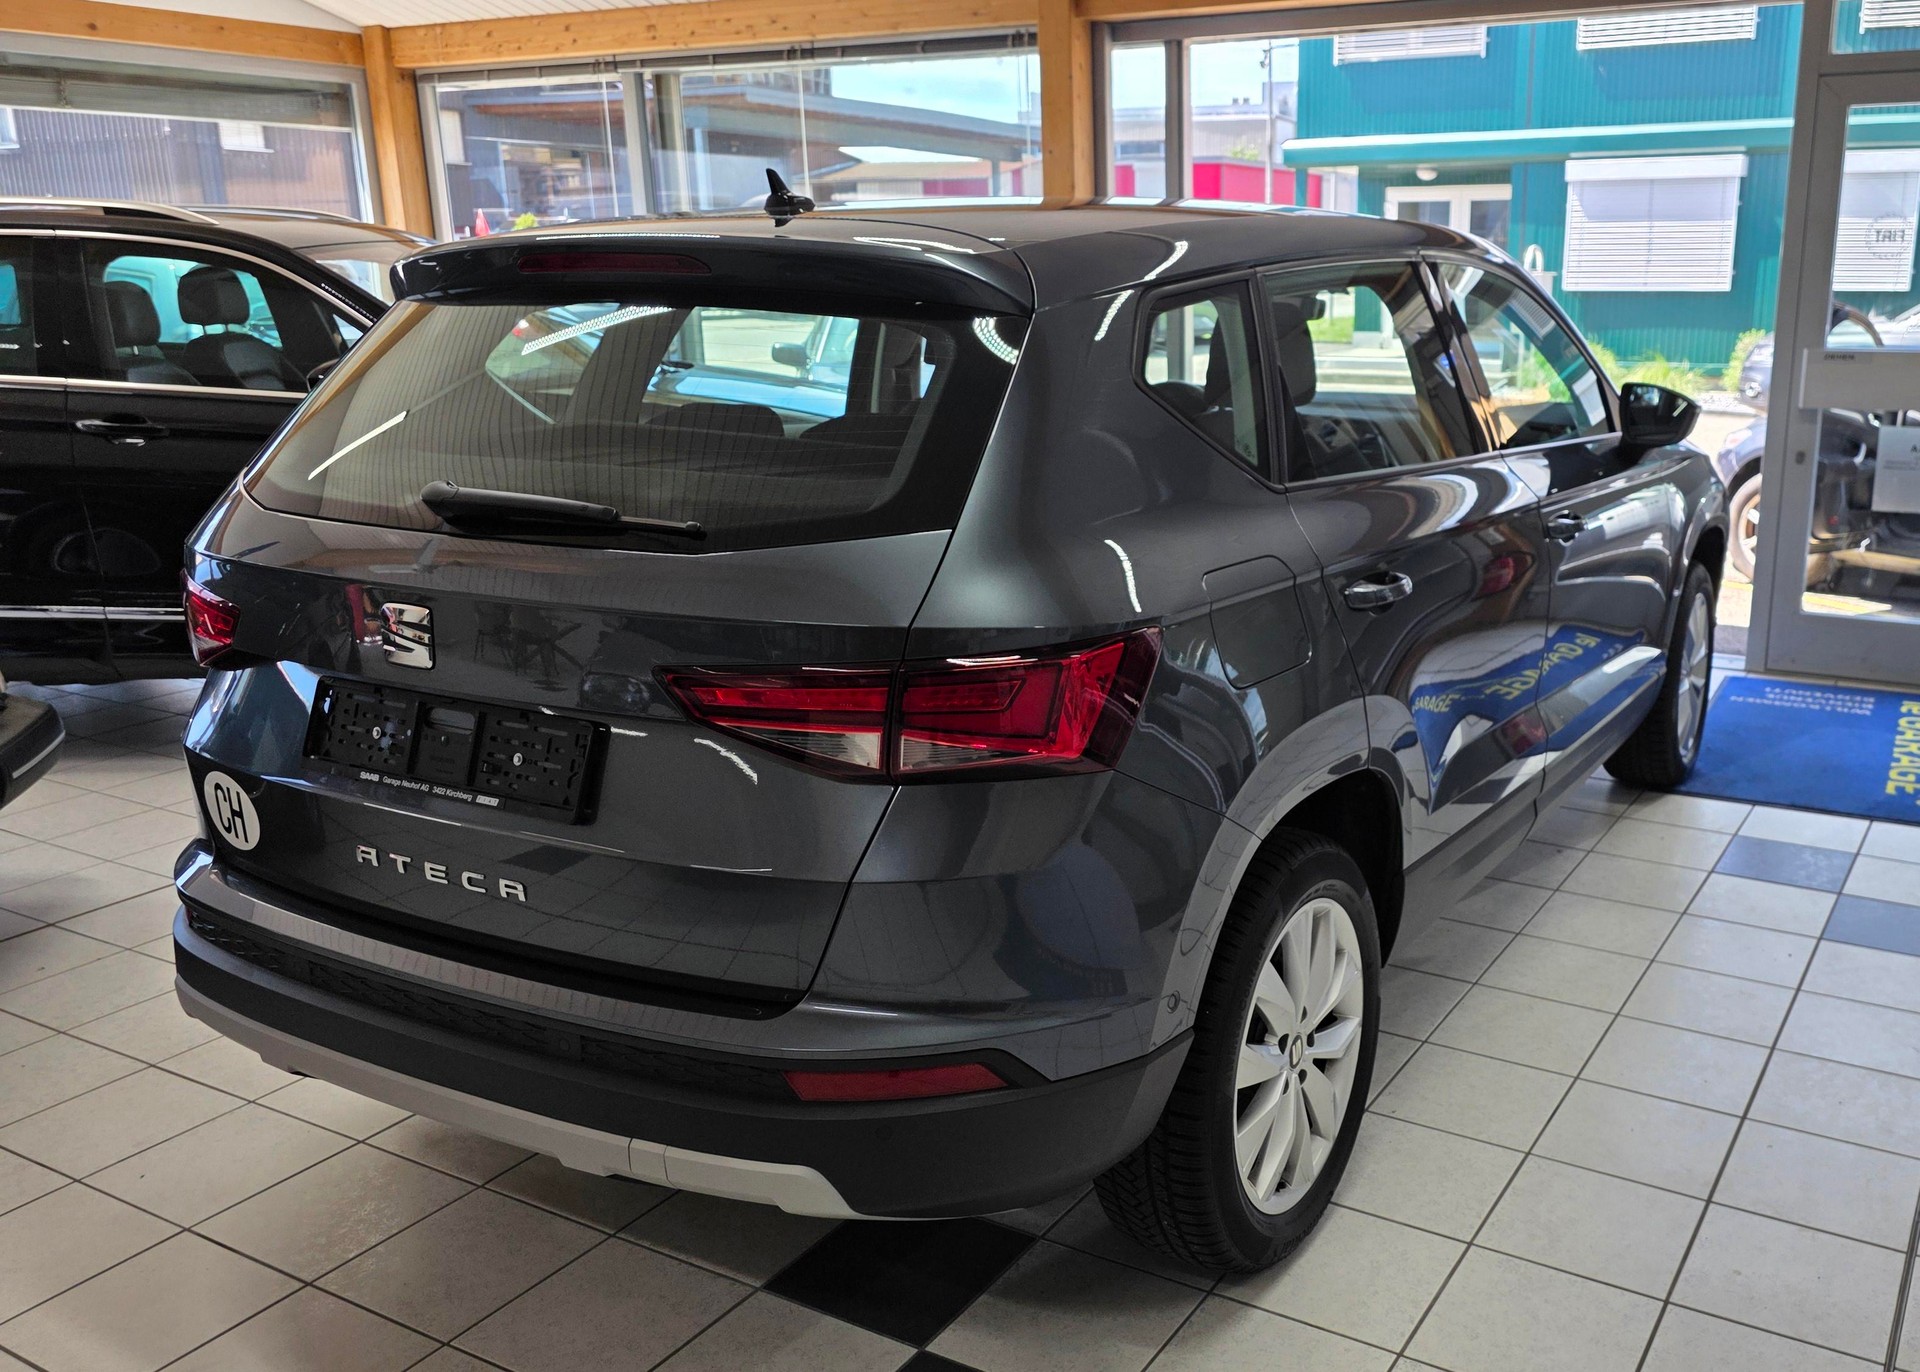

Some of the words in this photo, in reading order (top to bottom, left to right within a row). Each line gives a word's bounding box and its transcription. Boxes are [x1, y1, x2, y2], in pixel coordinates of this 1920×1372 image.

[214, 782, 249, 844] CH
[359, 771, 380, 782] SAAB
[382, 775, 401, 787] Garage
[401, 779, 421, 790] Neuhof
[420, 784, 430, 792] AG
[432, 786, 446, 796] 3422
[446, 788, 473, 802] Kirchberg
[356, 844, 527, 902] ATECA
